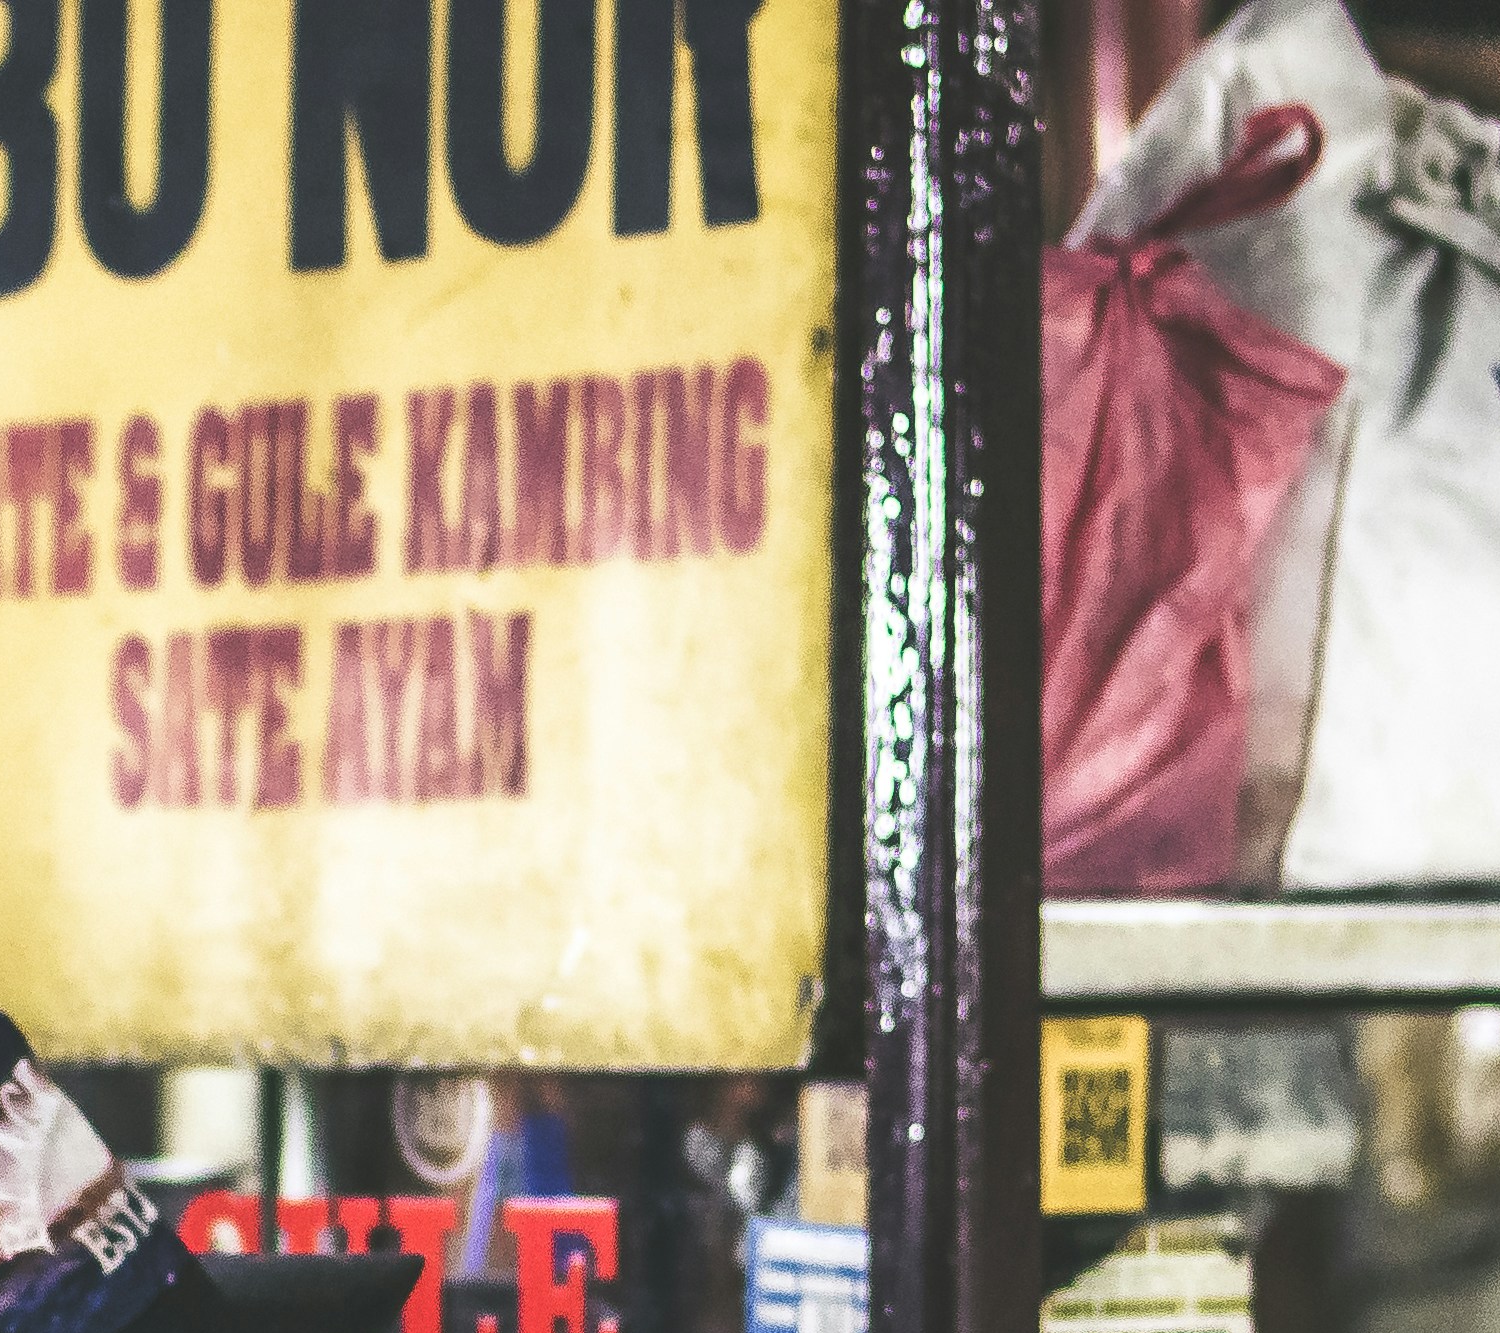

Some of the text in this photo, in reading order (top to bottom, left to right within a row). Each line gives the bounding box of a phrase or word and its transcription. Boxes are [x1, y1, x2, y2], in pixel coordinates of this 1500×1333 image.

[187, 392, 382, 588] GULE
[402, 355, 772, 578] KAMBING
[110, 608, 534, 814] SATE AYAM
